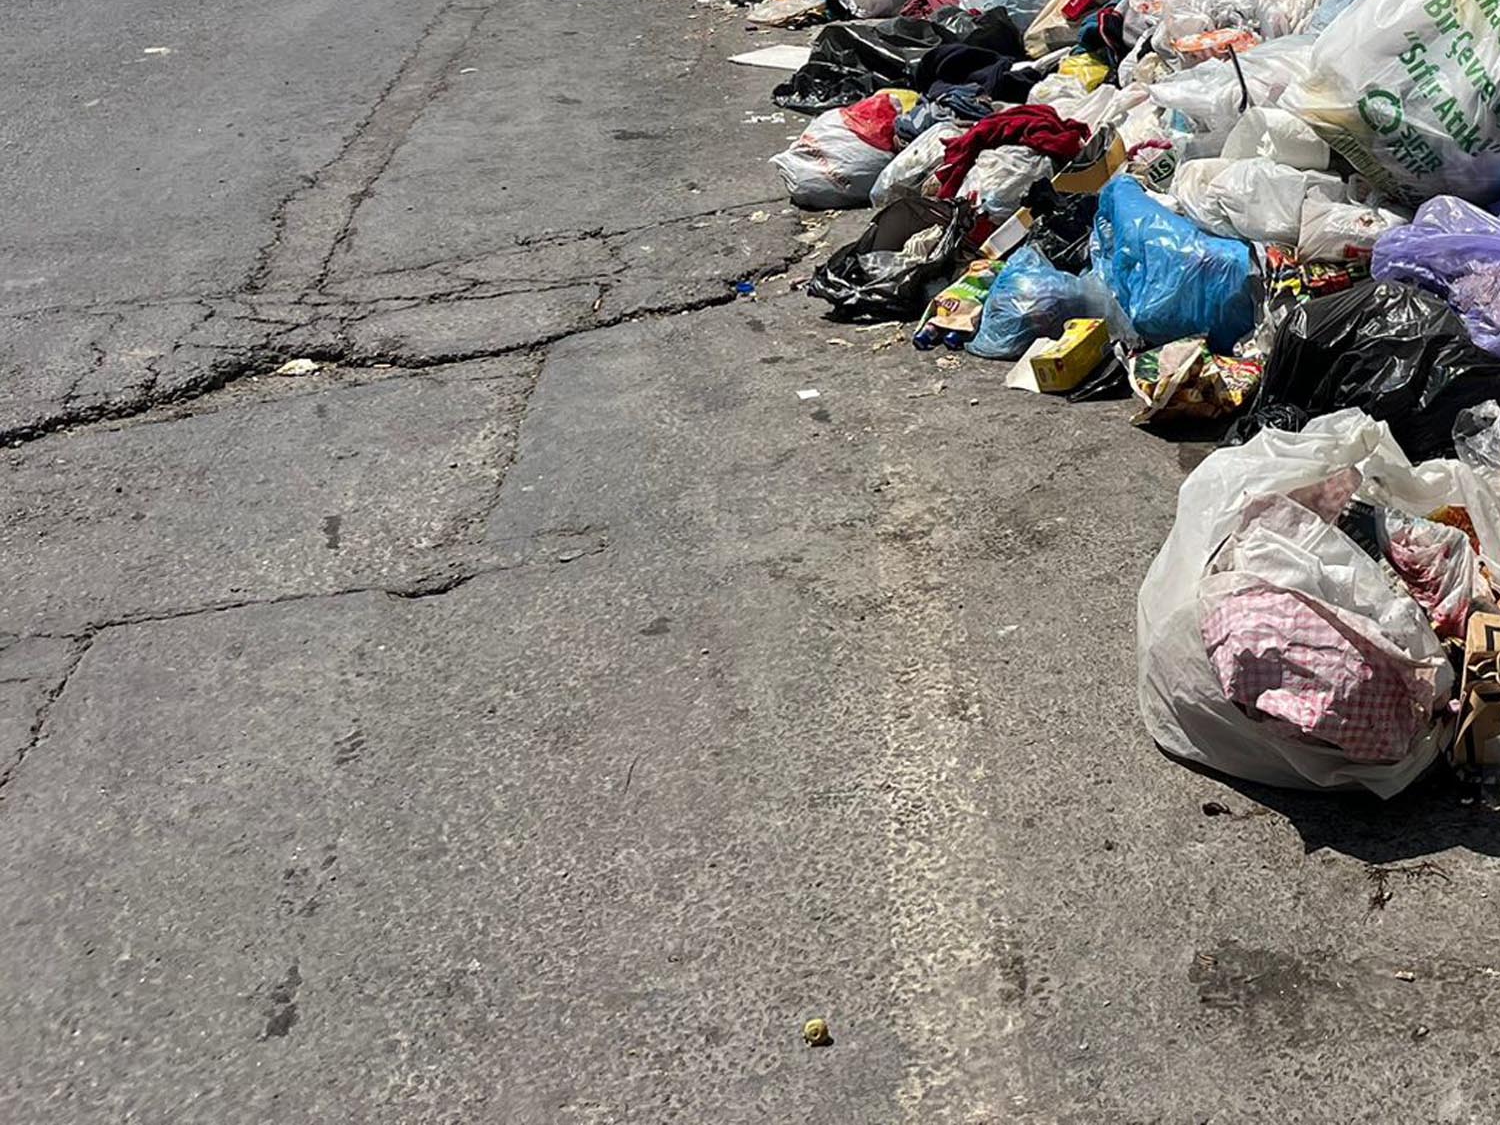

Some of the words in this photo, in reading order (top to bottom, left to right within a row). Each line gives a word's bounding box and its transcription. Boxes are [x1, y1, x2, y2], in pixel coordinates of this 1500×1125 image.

[1444, 30, 1497, 103] Çevre
[1388, 137, 1433, 180] ATIK
[1400, 123, 1444, 173] SIFIR
